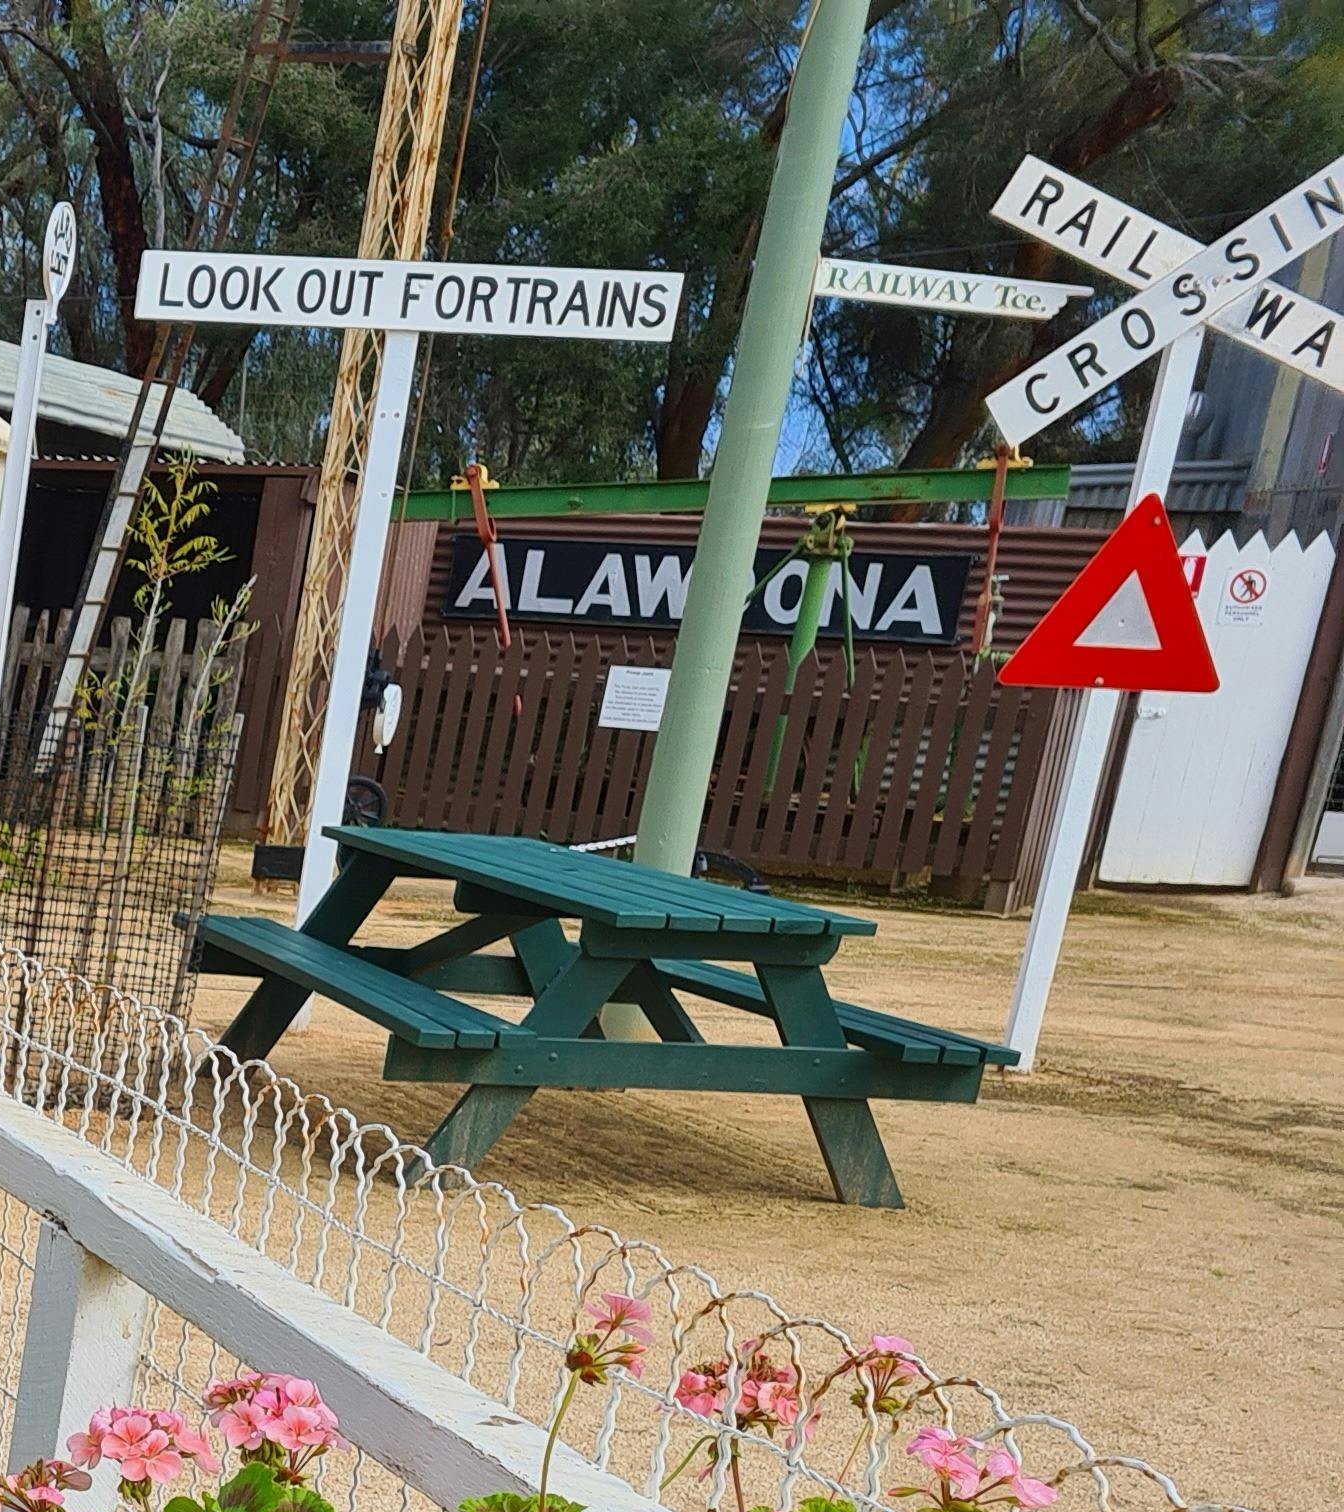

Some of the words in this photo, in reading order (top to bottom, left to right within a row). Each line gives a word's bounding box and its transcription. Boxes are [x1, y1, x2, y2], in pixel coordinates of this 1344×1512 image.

[158, 262, 286, 313] LOOK
[296, 268, 384, 317] OUT
[825, 267, 982, 304] RAILWAY
[993, 282, 1047, 313] Tce.
[454, 541, 944, 635] ALAWONA
